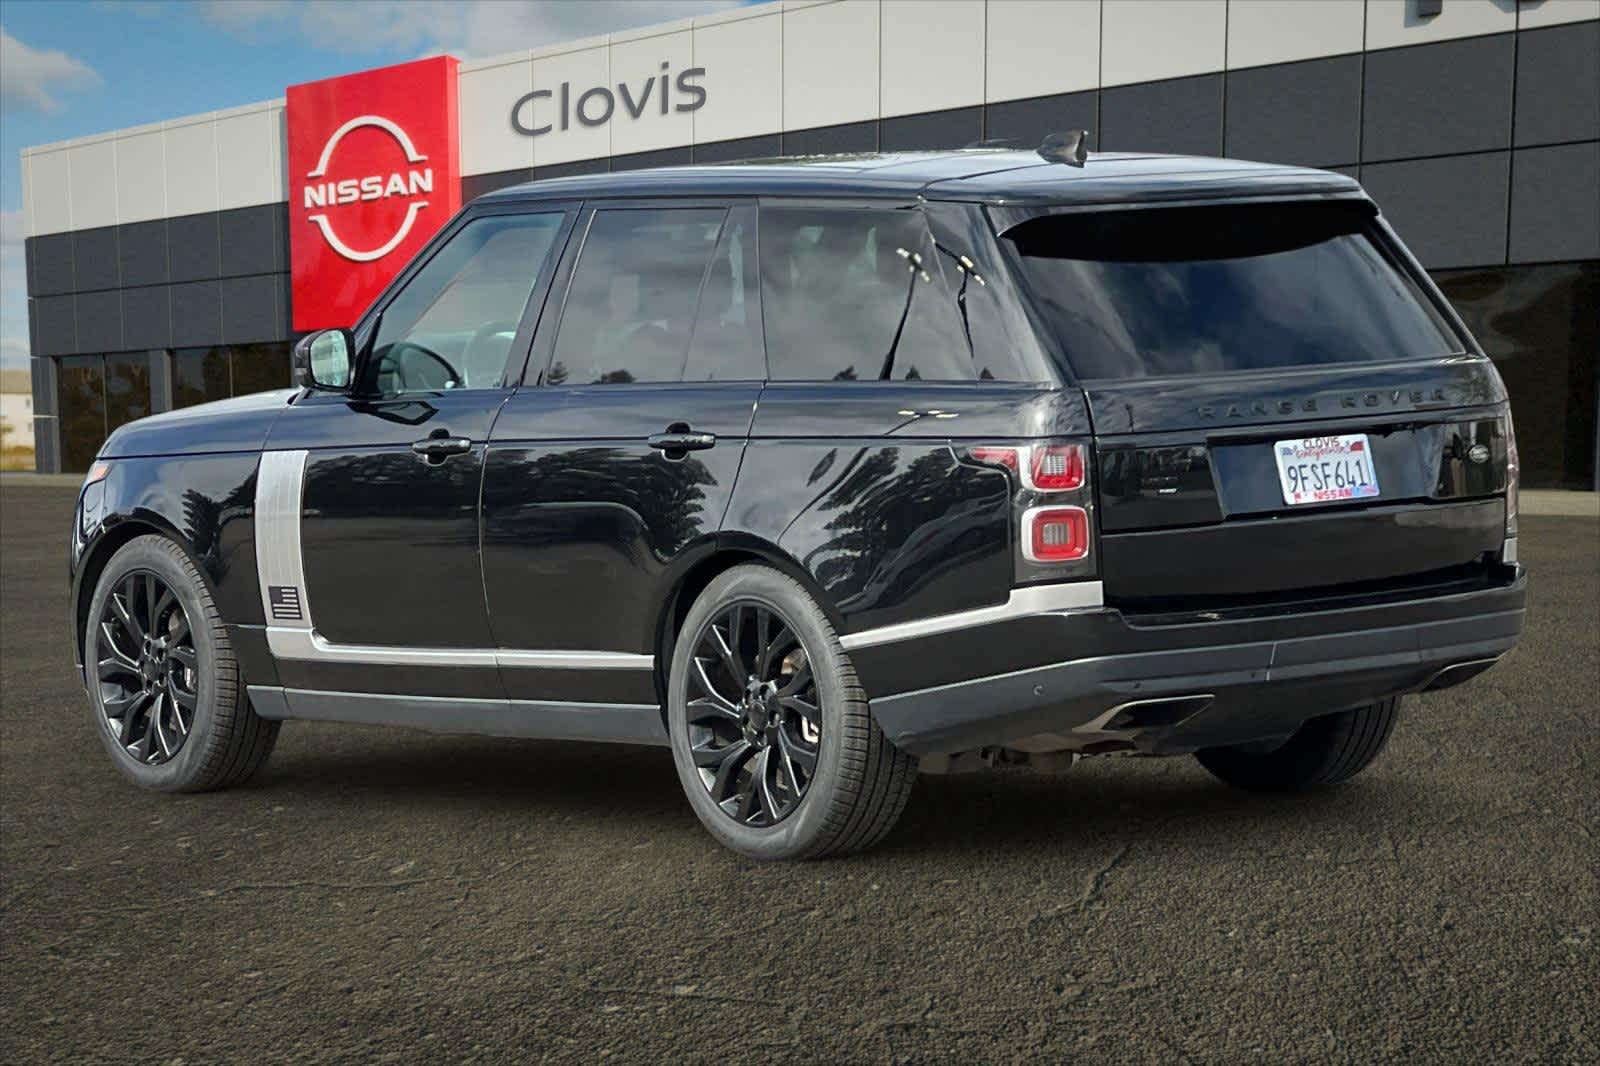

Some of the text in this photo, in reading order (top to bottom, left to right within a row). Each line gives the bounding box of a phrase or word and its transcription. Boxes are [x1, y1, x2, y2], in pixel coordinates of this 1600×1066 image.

[510, 62, 708, 136] Clovis
[304, 168, 433, 208] NISSAN
[1197, 389, 1447, 420] RANGE ROVER
[1303, 437, 1341, 449] CLOVIS
[1288, 459, 1367, 493] 9FSF641
[1313, 487, 1353, 500] NISSAN
